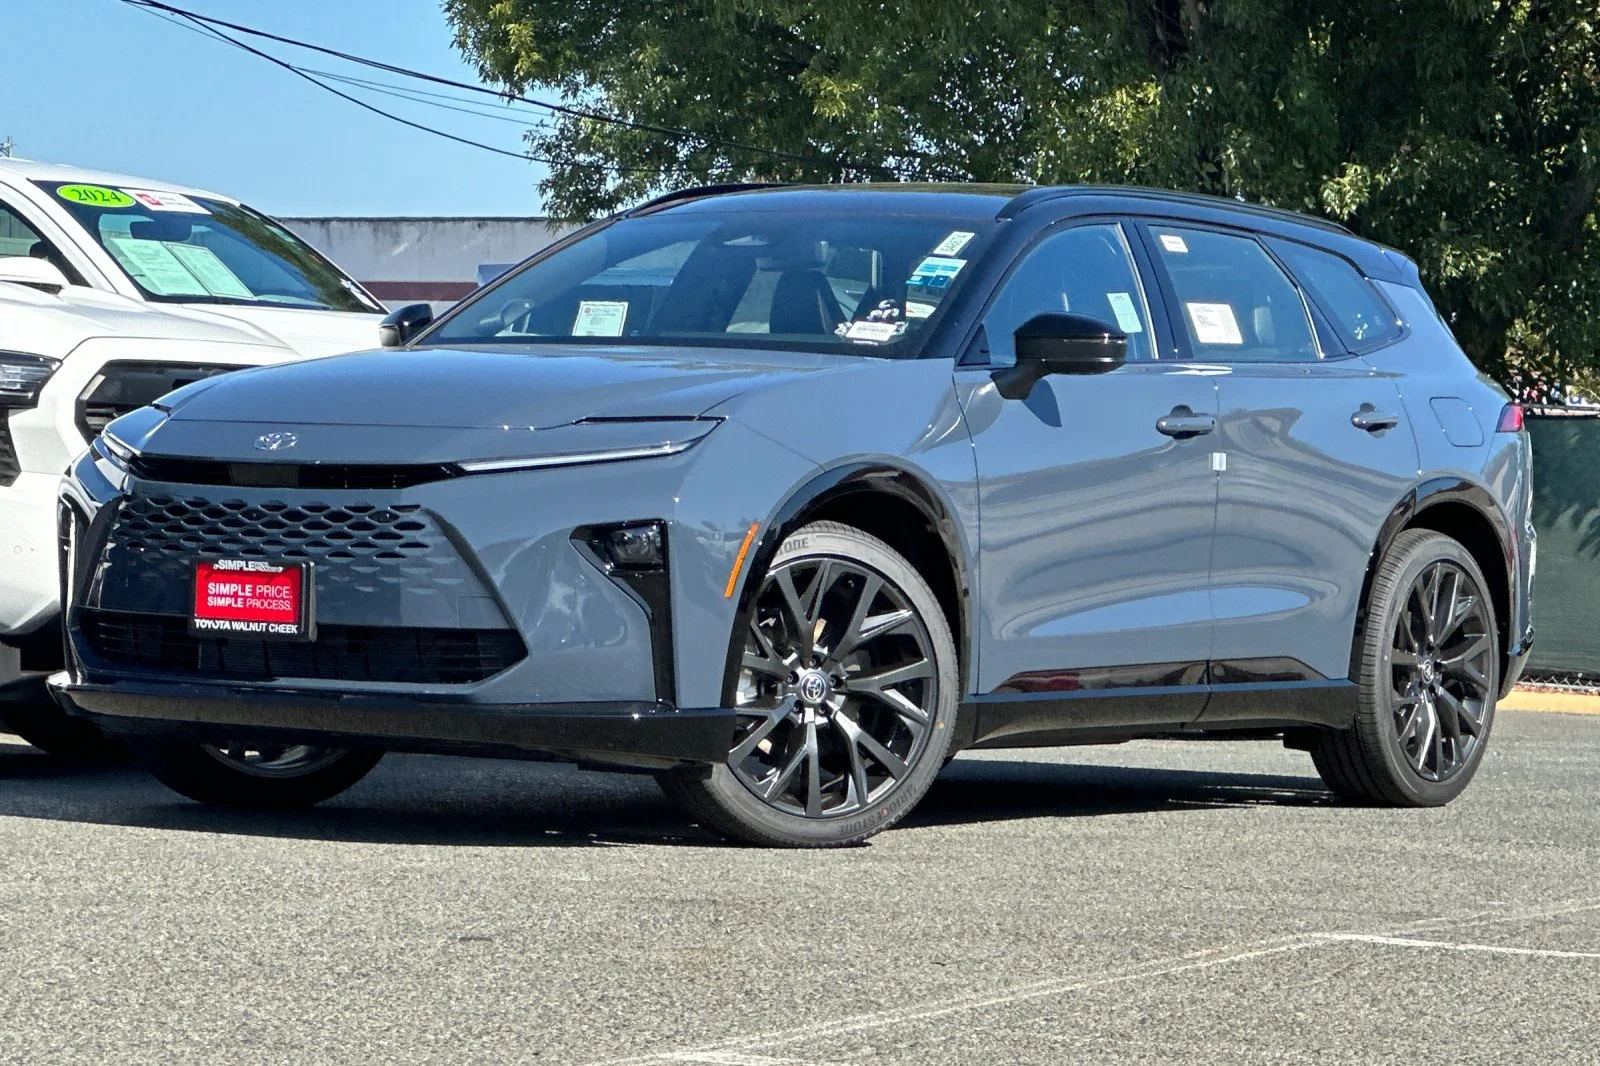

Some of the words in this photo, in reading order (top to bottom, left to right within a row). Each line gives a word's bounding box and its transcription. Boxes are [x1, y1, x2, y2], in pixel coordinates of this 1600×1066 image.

[71, 188, 121, 202] 2024
[218, 559, 257, 571] SIMPLE
[208, 582, 253, 596] SIMPLE
[256, 585, 293, 598] PRICE.
[208, 597, 244, 608] SIMPLE
[246, 599, 293, 611] PROCESS.
[194, 619, 231, 630] TOYOTA
[231, 621, 267, 632] WALNUT
